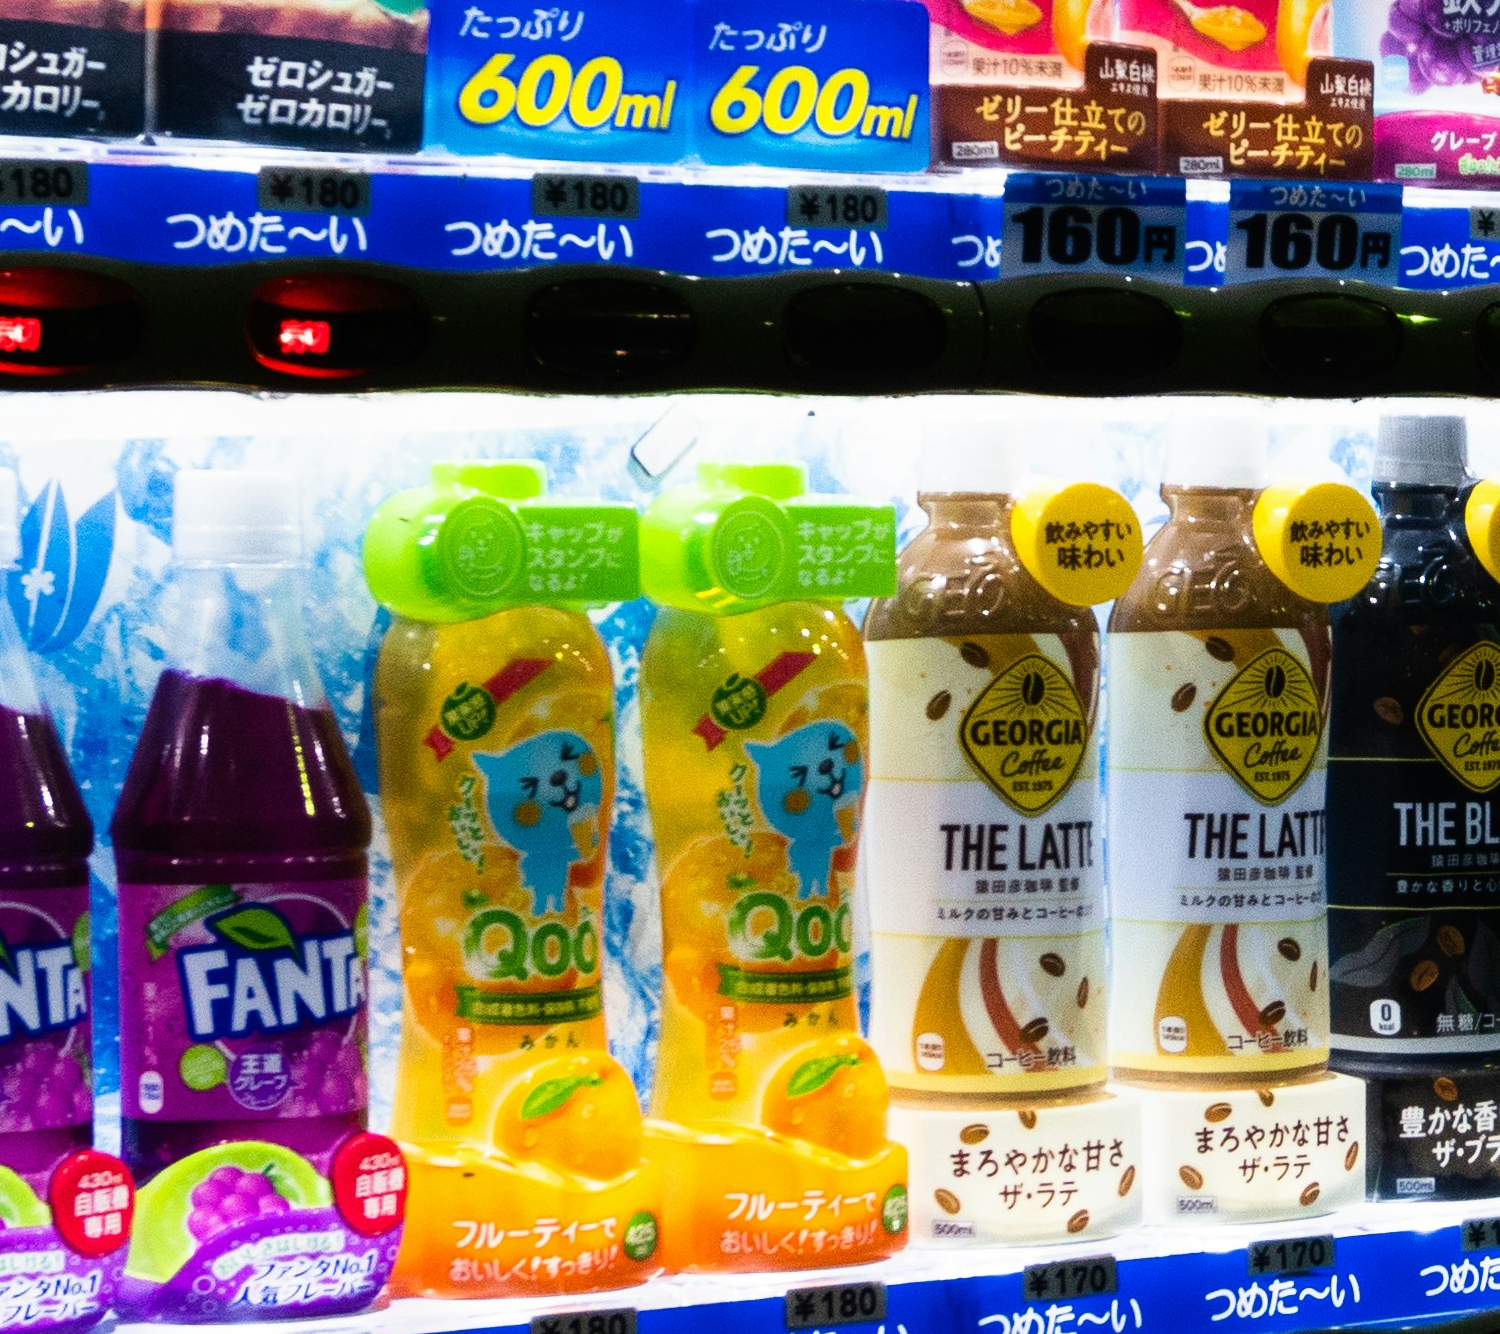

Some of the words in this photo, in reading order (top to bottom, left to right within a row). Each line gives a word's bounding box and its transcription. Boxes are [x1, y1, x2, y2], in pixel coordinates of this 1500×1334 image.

[459, 6, 585, 42] たっぷり
[708, 22, 827, 53] たっぷり
[247, 55, 394, 97] ゼロシュガー
[976, 95, 1147, 136] ゼリー仕立ての
[1004, 125, 1128, 161] ピーチティー
[1012, 205, 1176, 266] 160円
[1237, 213, 1391, 270] 160円
[1046, 521, 1131, 545] 飲みやすい
[1057, 544, 1125, 570] 味わい
[970, 719, 1083, 747] GEORGIA
[1215, 710, 1318, 738] GEORGIA
[1001, 748, 1066, 779] Coffee
[1394, 802, 1456, 847] THE
[182, 934, 364, 1037] FANTA
[519, 1032, 578, 1051] みかん
[987, 1048, 1077, 1068] コーヒー飲料
[950, 1139, 1124, 1178] まろやかな甘さ
[998, 1182, 1079, 1211] ザ・ラテ
[451, 1218, 618, 1250] フルーティーで
